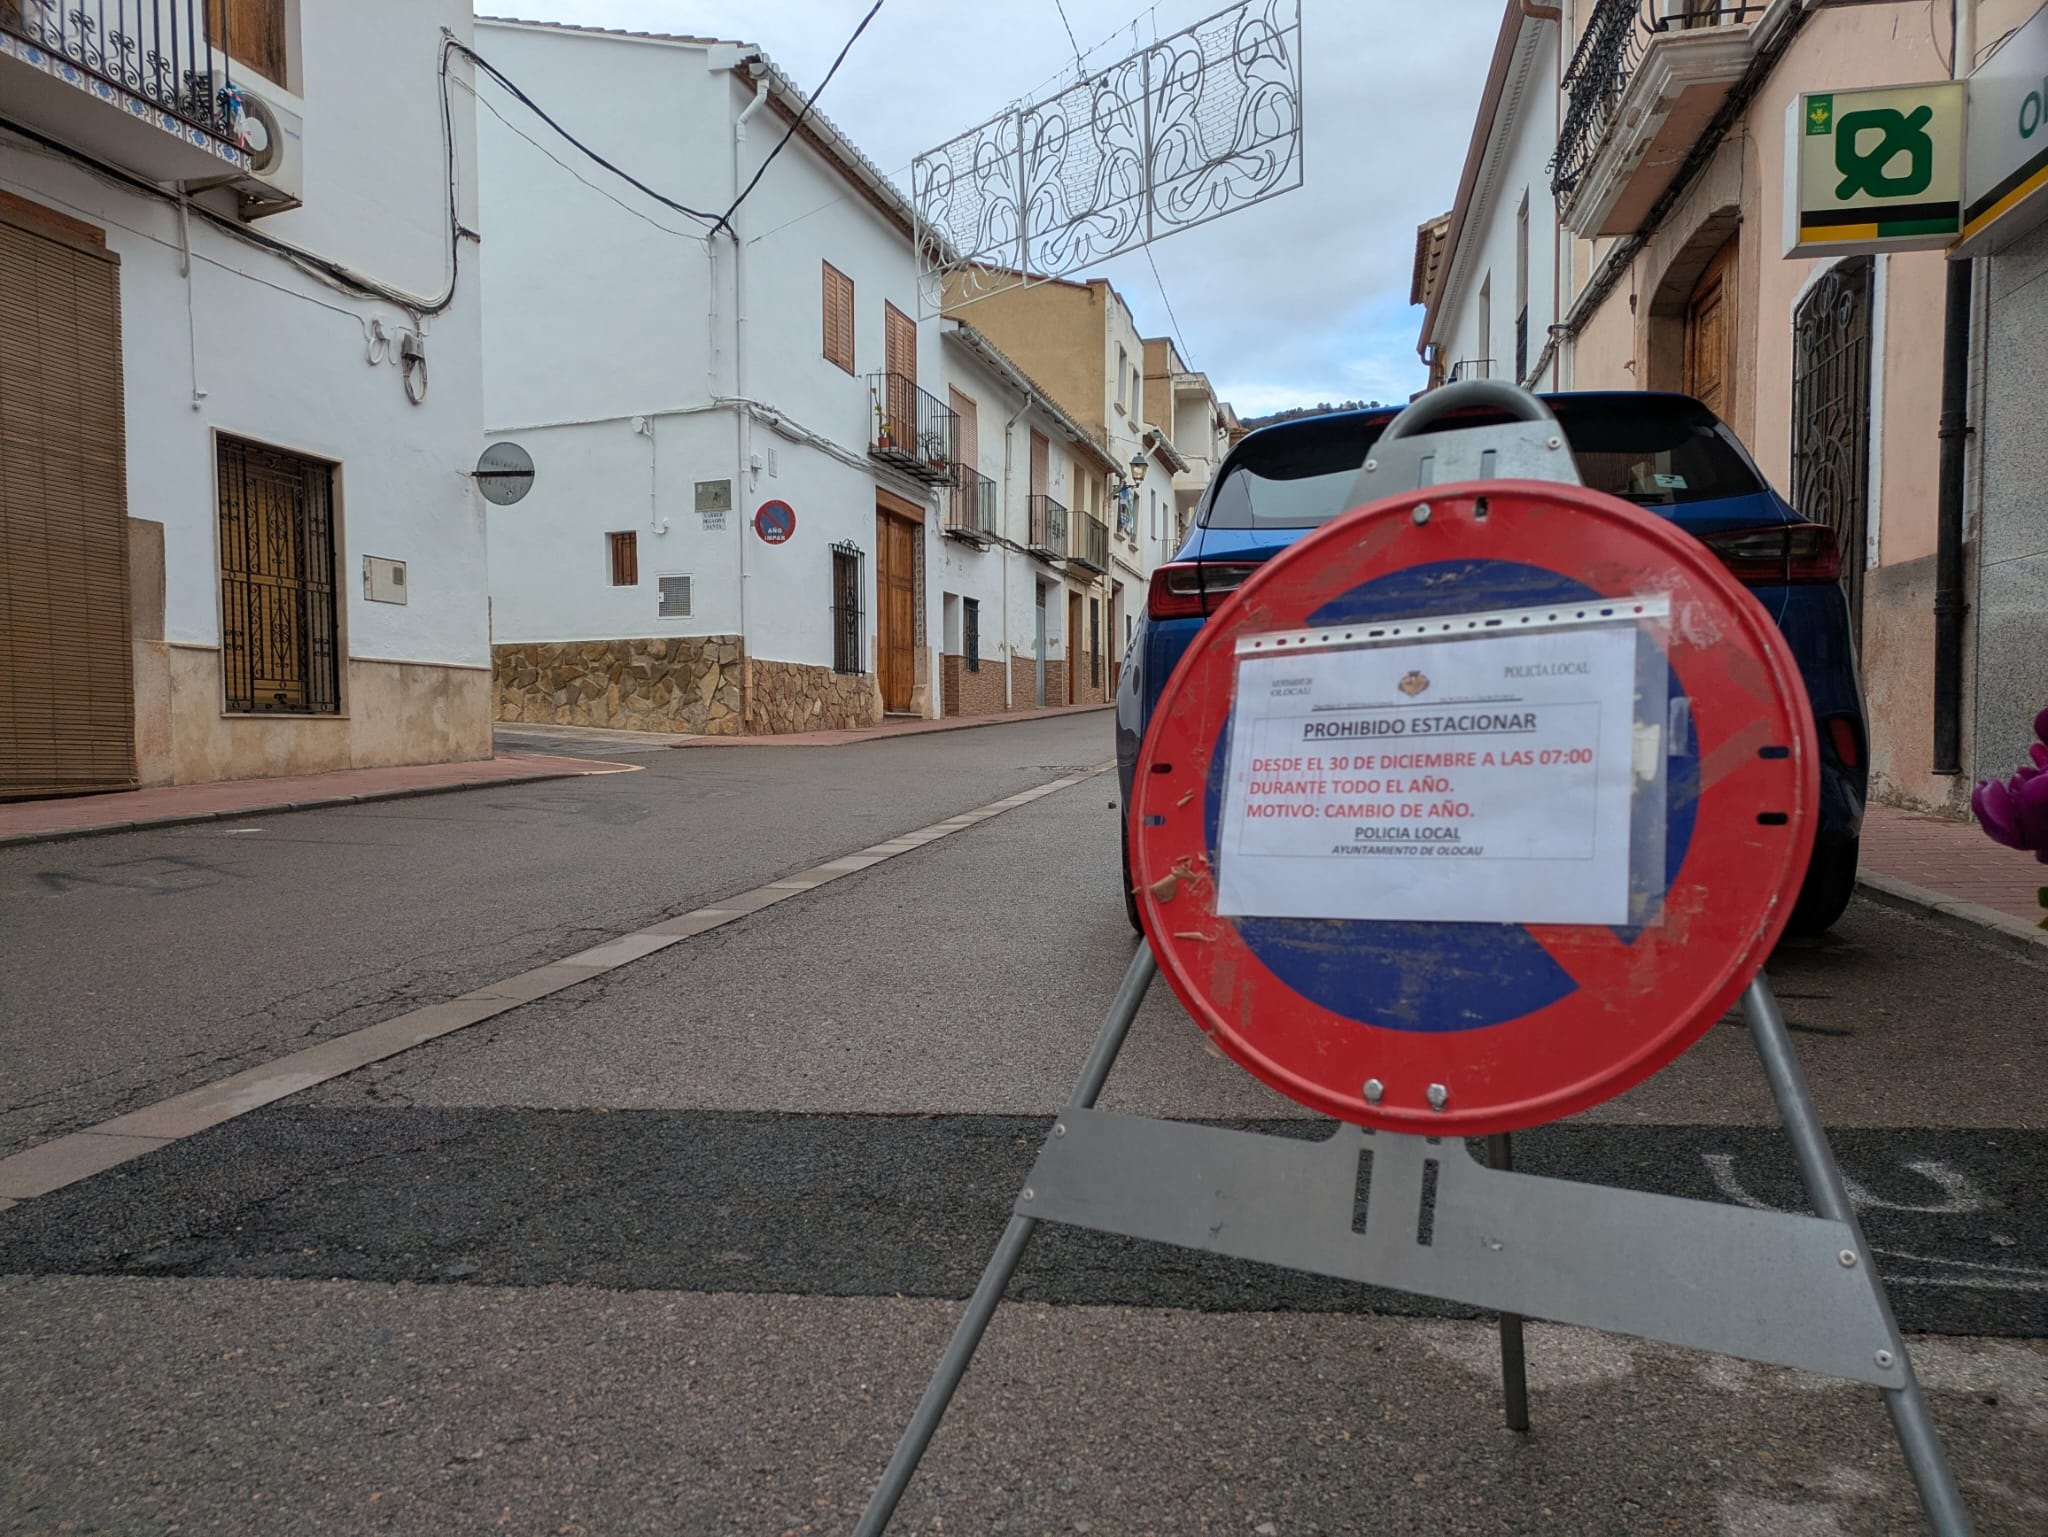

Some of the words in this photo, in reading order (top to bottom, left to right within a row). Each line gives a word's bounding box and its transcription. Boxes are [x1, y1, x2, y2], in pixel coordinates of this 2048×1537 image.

[1551, 661, 1590, 675] LOCAL
[1303, 718, 1406, 739] PROHIBIDO
[1411, 713, 1537, 734] ESTACIONAR
[1252, 757, 1302, 772] DESDE
[1306, 757, 1324, 771] EL
[1329, 756, 1349, 771] 30
[1353, 755, 1375, 770] DE
[1380, 752, 1477, 769] DICIEMBRE
[1481, 751, 1496, 767] A
[1501, 750, 1534, 766] LAS
[1539, 748, 1593, 766] 07:00
[1249, 780, 1326, 795] DURANTE
[1332, 779, 1381, 794] TODO
[1386, 779, 1404, 794] EL
[1408, 775, 1454, 793] AÑO.
[1246, 803, 1320, 818] MOTIVO:
[1324, 803, 1396, 818] CAMBIO
[1400, 803, 1423, 818] DE
[1428, 800, 1475, 818] AÑO.
[1355, 826, 1411, 840] POLICIA
[1415, 826, 1461, 840] LOCAL
[1331, 845, 1417, 855] AYUNTAMIENTO
[1420, 845, 1435, 856] DE
[1436, 845, 1484, 857] OLOCAU
